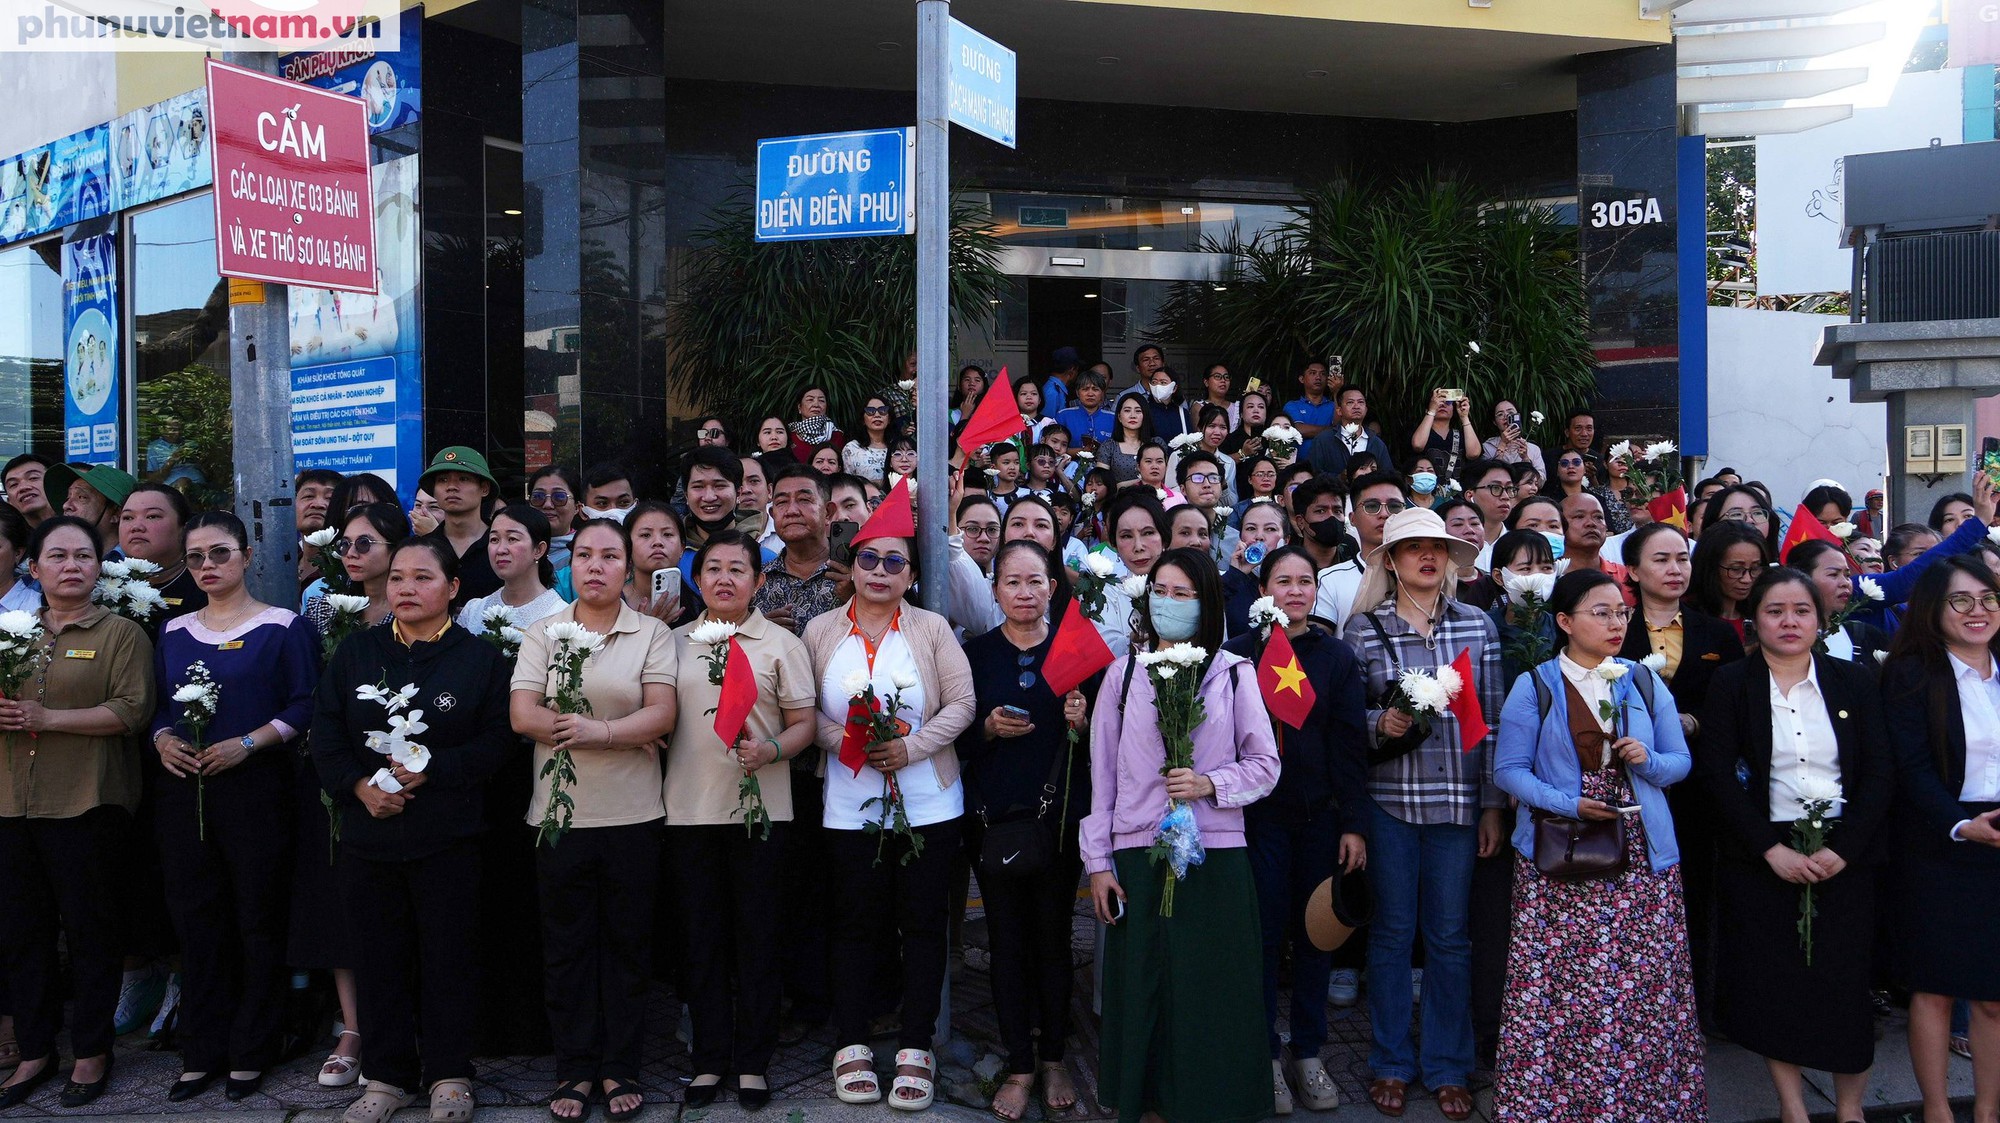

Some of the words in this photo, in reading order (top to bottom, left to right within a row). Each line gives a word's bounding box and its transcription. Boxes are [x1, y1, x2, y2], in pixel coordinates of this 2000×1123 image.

[962, 43, 1001, 84] ĐƯỜNG
[257, 103, 327, 162] CẤM
[967, 89, 987, 126] MẠNG
[987, 96, 1009, 134] THÁNG
[787, 147, 871, 178] ĐƯỜNG
[230, 162, 257, 201] CÁC
[259, 173, 288, 211] LOẠI
[290, 179, 307, 211] XE
[309, 183, 322, 213] 03
[325, 180, 359, 219] BÁNH
[760, 190, 802, 233] ĐIỆN
[809, 188, 852, 227] BIÊN
[859, 180, 898, 223] PHỦ
[1591, 198, 1663, 228] 305A
[229, 217, 247, 256] VÀ
[249, 227, 267, 259] XE
[270, 228, 294, 263] THÔ
[297, 235, 314, 266] SƠ
[317, 238, 331, 268] 04
[334, 235, 367, 272] BÁNH
[346, 389, 365, 399] DOANH
[365, 385, 385, 398] NGHIỆP
[362, 406, 378, 416] KHOA
